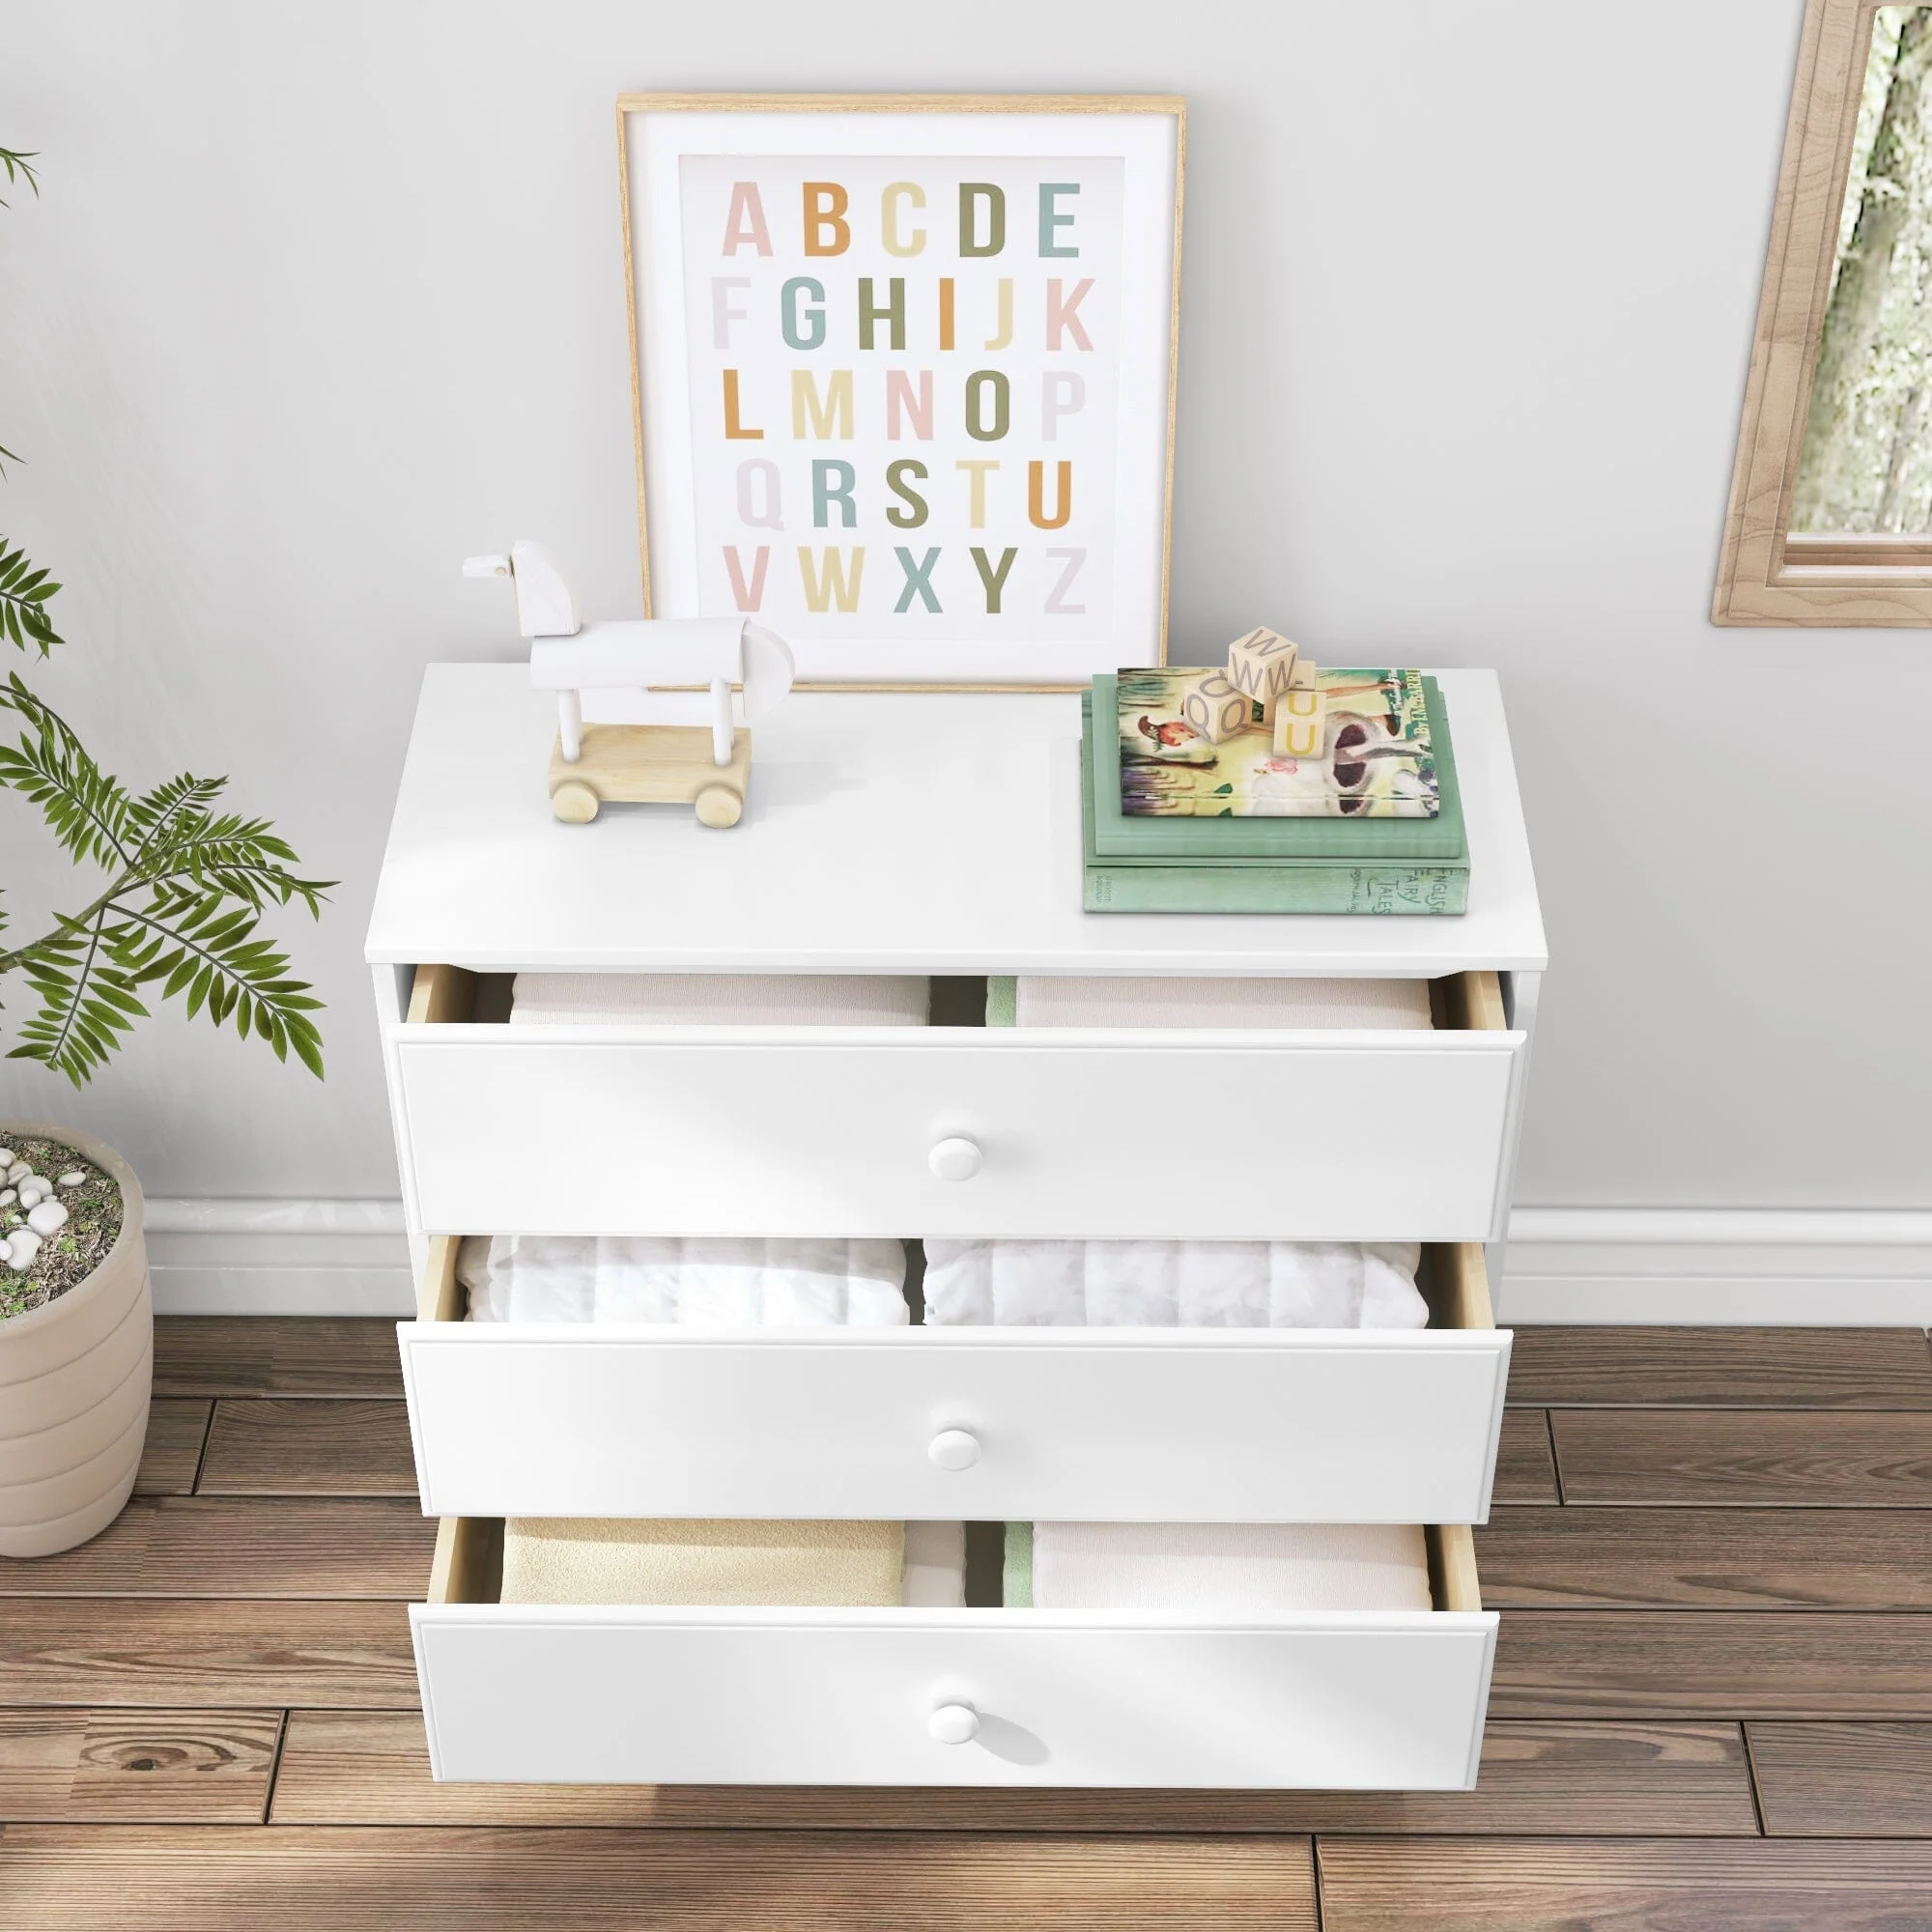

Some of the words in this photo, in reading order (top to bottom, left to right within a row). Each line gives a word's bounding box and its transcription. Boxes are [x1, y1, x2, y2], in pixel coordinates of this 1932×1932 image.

[722, 182, 774, 257] A
[803, 182, 851, 257] B
[881, 182, 927, 258] C
[959, 183, 1006, 258] D
[1038, 183, 1081, 258] E
[711, 276, 752, 350] F
[781, 276, 826, 351] G
[858, 277, 906, 351] H
[939, 277, 955, 351] I
[984, 278, 1014, 352] J
[1045, 278, 1096, 352] K
[723, 369, 764, 440] L
[791, 369, 854, 440] M
[886, 370, 933, 440] N
[965, 370, 1010, 441] O
[1041, 371, 1086, 441] P
[736, 458, 784, 531] Q
[811, 459, 858, 528] R
[886, 459, 929, 529] S
[955, 460, 1001, 529] T
[1028, 461, 1071, 530] U
[723, 546, 771, 613] V
[797, 546, 866, 613] W
[893, 547, 944, 613] X
[969, 547, 1018, 614] Y
[1043, 548, 1087, 614] Z
[1232, 652, 1264, 696] W
[1267, 652, 1296, 696] W
[1186, 694, 1211, 742] Q
[1221, 698, 1249, 734] Q
[1286, 724, 1316, 755] U
[1372, 879, 1399, 914] TALES
